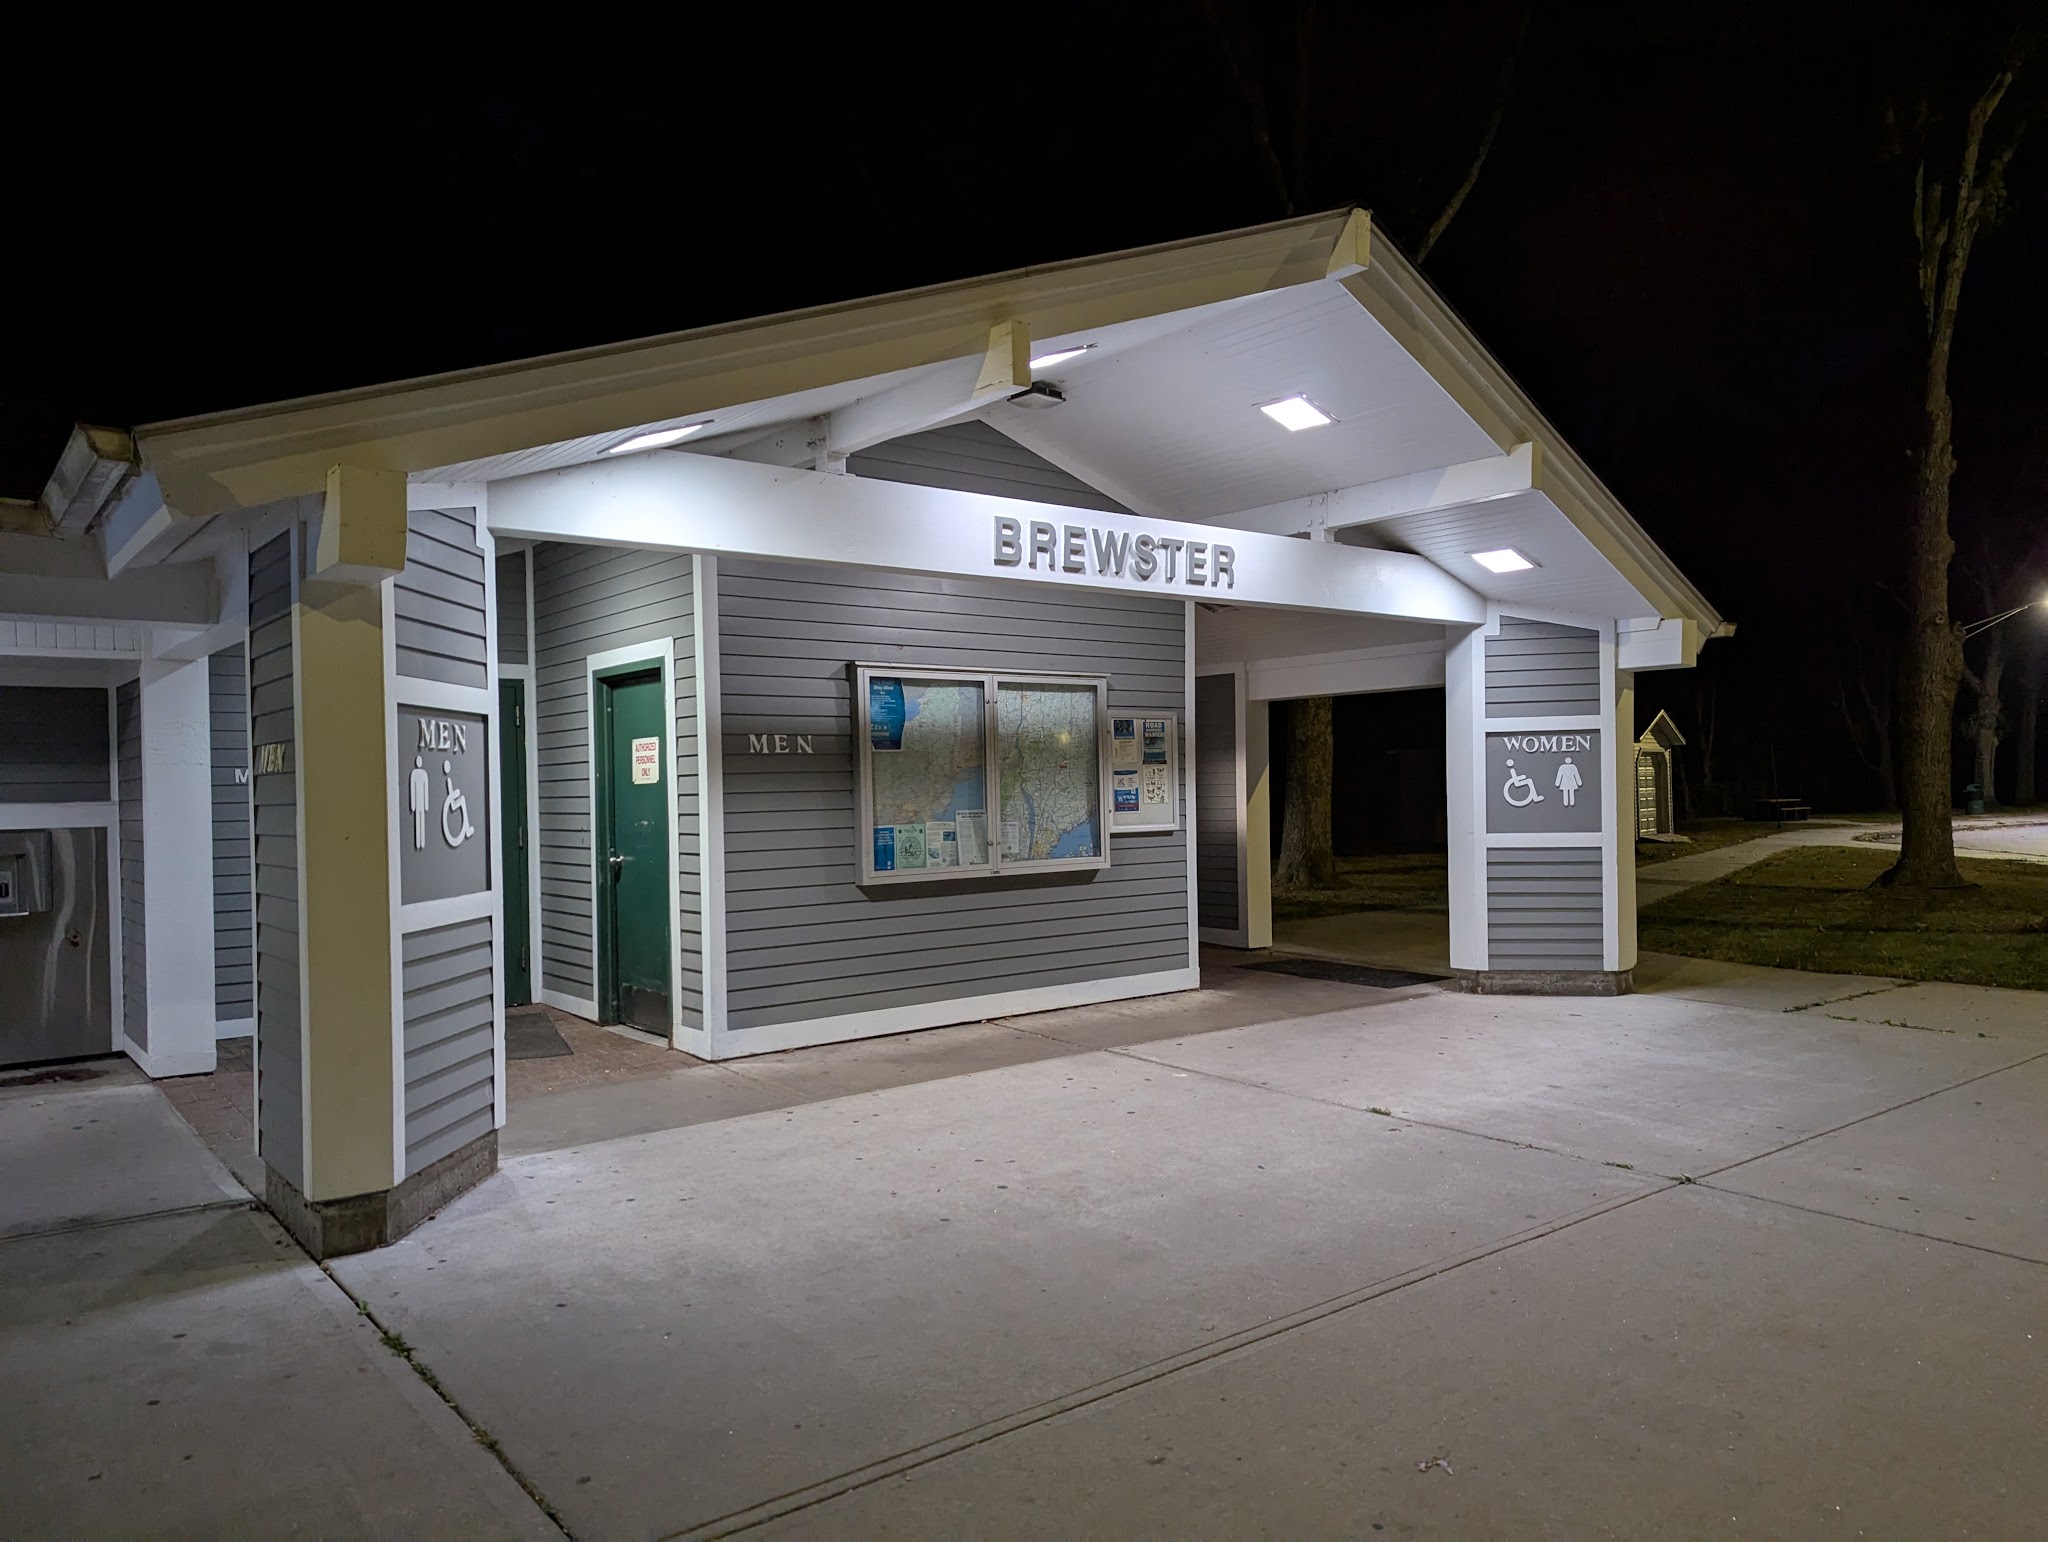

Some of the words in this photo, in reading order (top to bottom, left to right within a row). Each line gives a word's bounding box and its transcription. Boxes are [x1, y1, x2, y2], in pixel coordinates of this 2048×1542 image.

[994, 515, 1236, 589] BREWSTER
[418, 718, 466, 752] MEN
[747, 733, 814, 754] MEN
[1503, 735, 1592, 753] WOMEN
[635, 742, 657, 753] AUTHORIZED
[258, 743, 287, 774] MEN
[635, 754, 657, 765] PERSONNEL
[641, 767, 651, 777] ONLY
